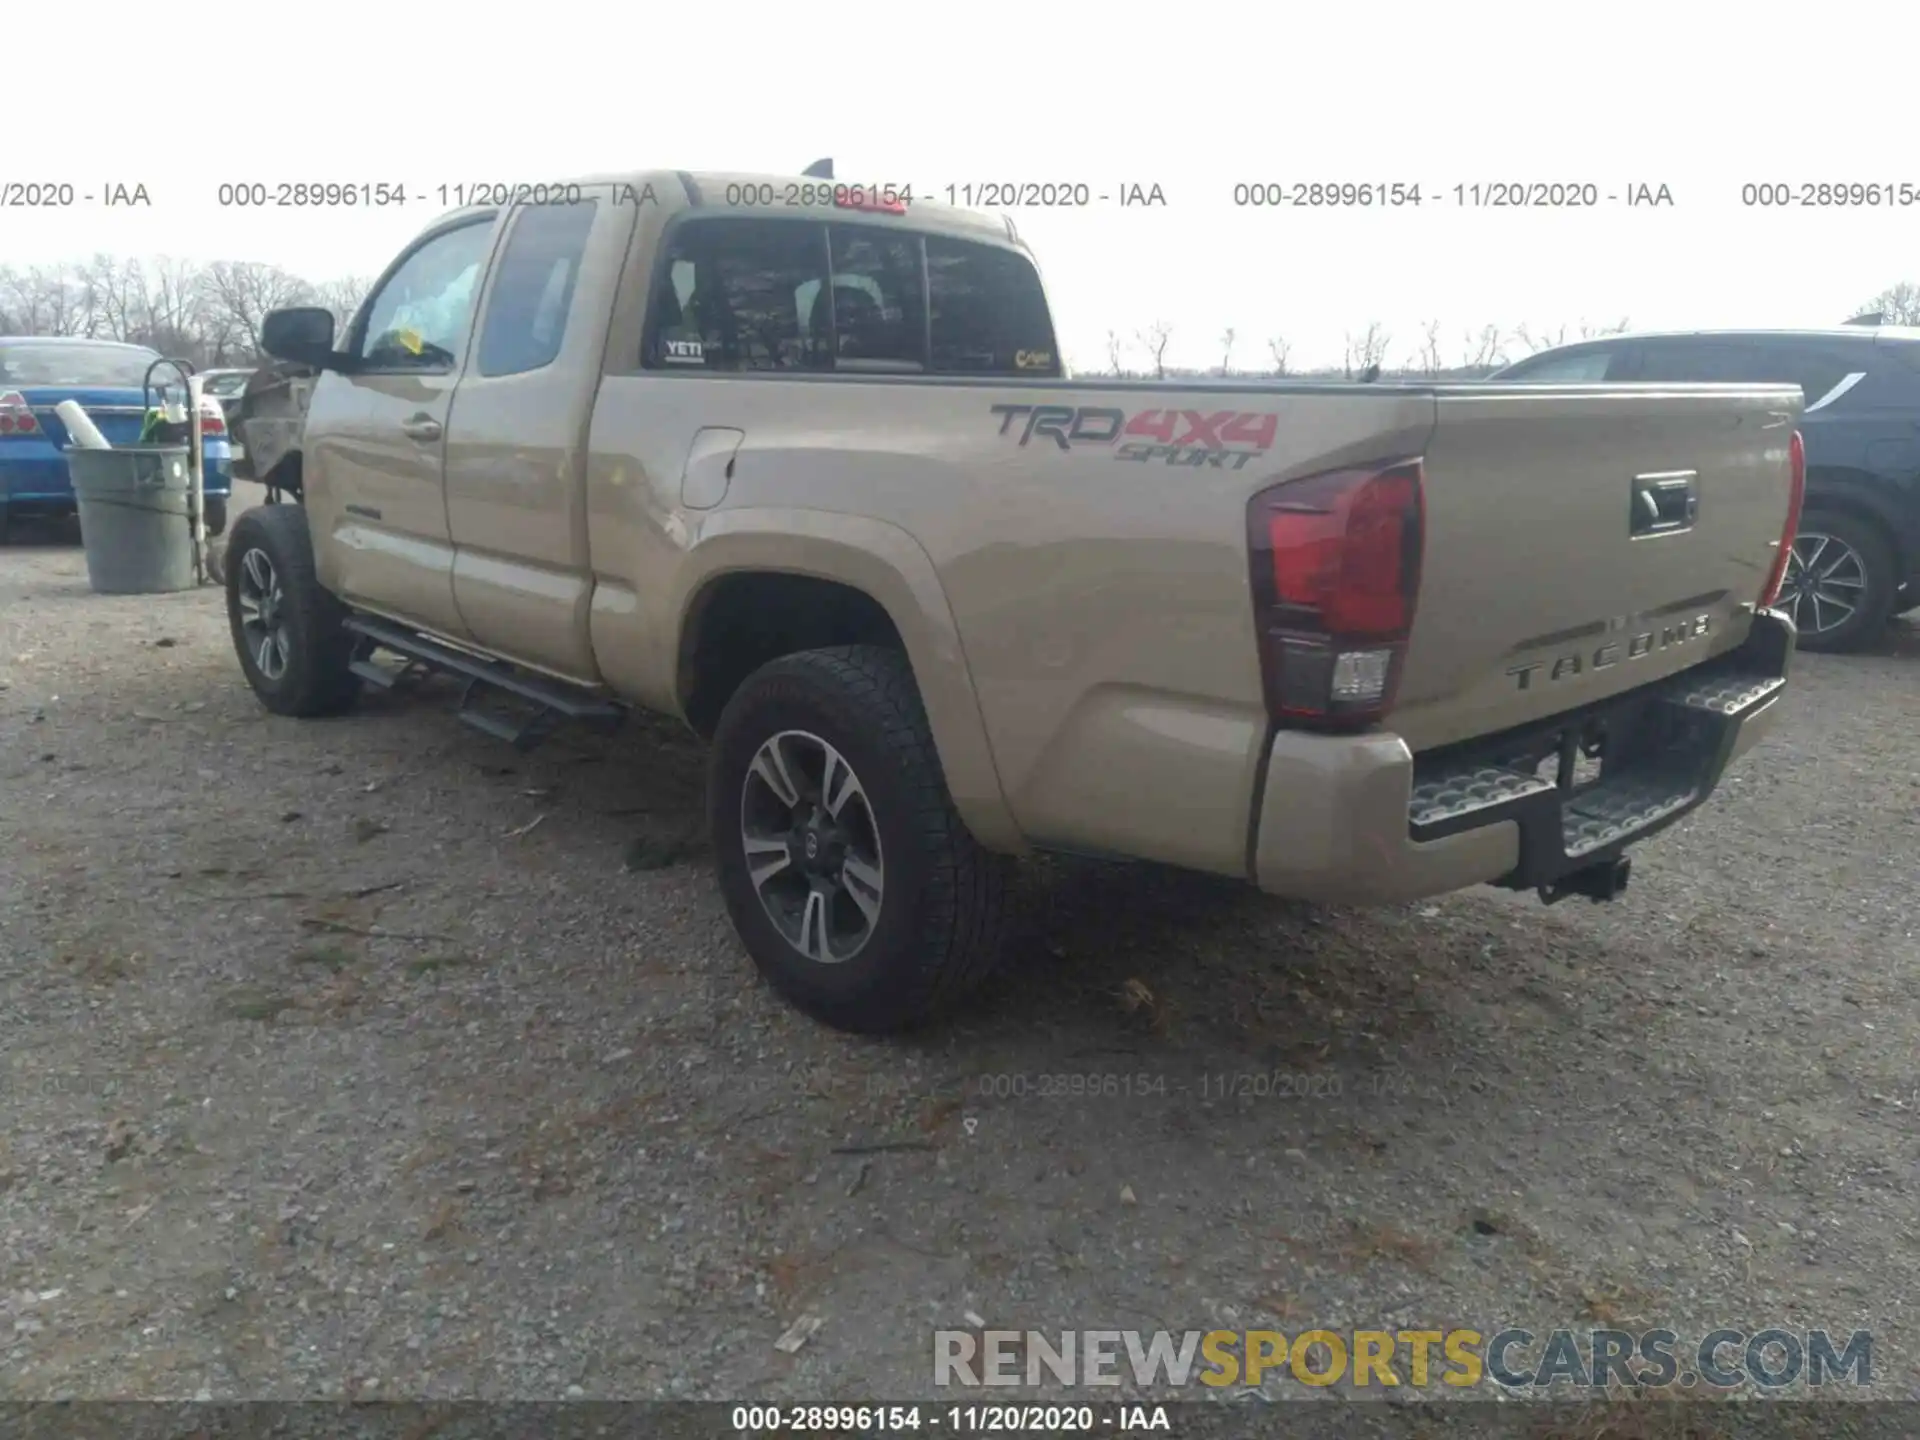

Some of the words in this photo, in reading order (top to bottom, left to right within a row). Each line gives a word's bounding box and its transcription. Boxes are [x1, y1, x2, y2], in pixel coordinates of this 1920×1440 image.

[666, 340, 702, 356] YETI
[990, 404, 1125, 450] TRD
[1114, 443, 1263, 470] SPORT
[1505, 614, 1709, 690] TACOMA
